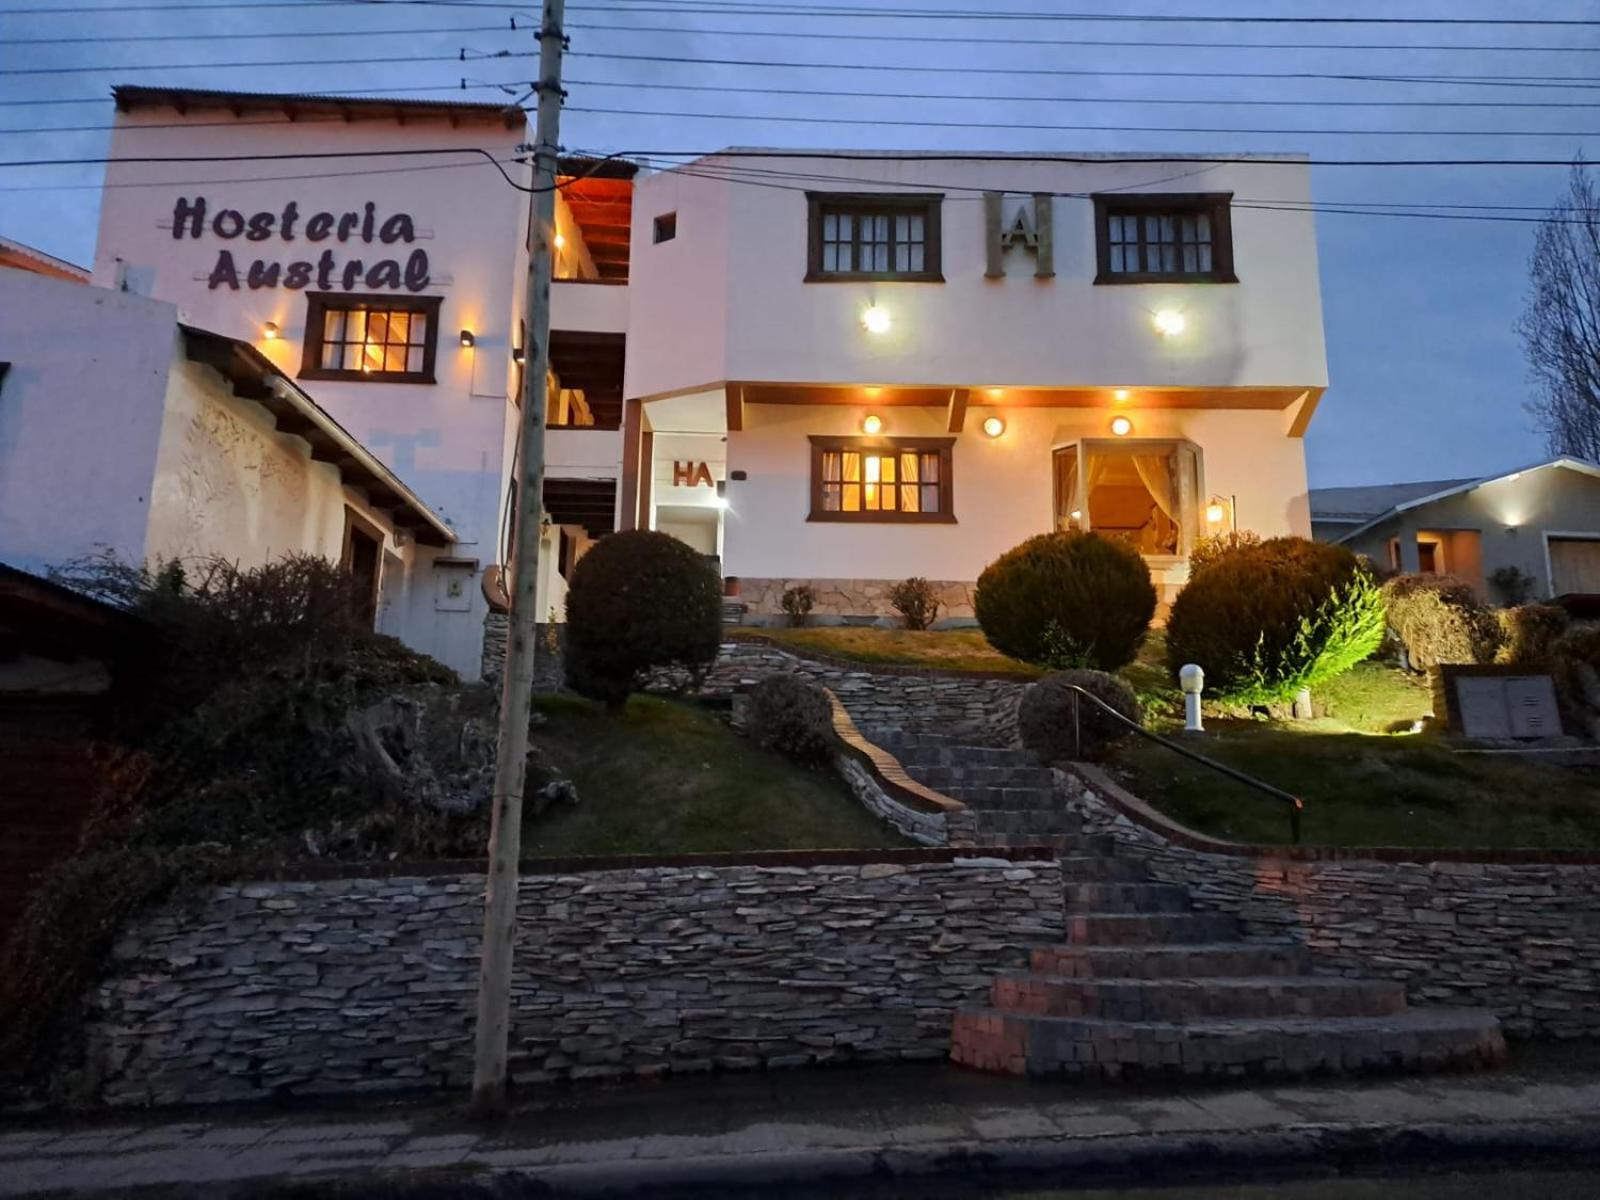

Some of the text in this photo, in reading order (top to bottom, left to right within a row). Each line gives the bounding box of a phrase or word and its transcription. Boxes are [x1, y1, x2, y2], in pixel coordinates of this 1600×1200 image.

[172, 197, 415, 243] Hosteria
[208, 248, 430, 292] Austral
[673, 461, 713, 487] HA
